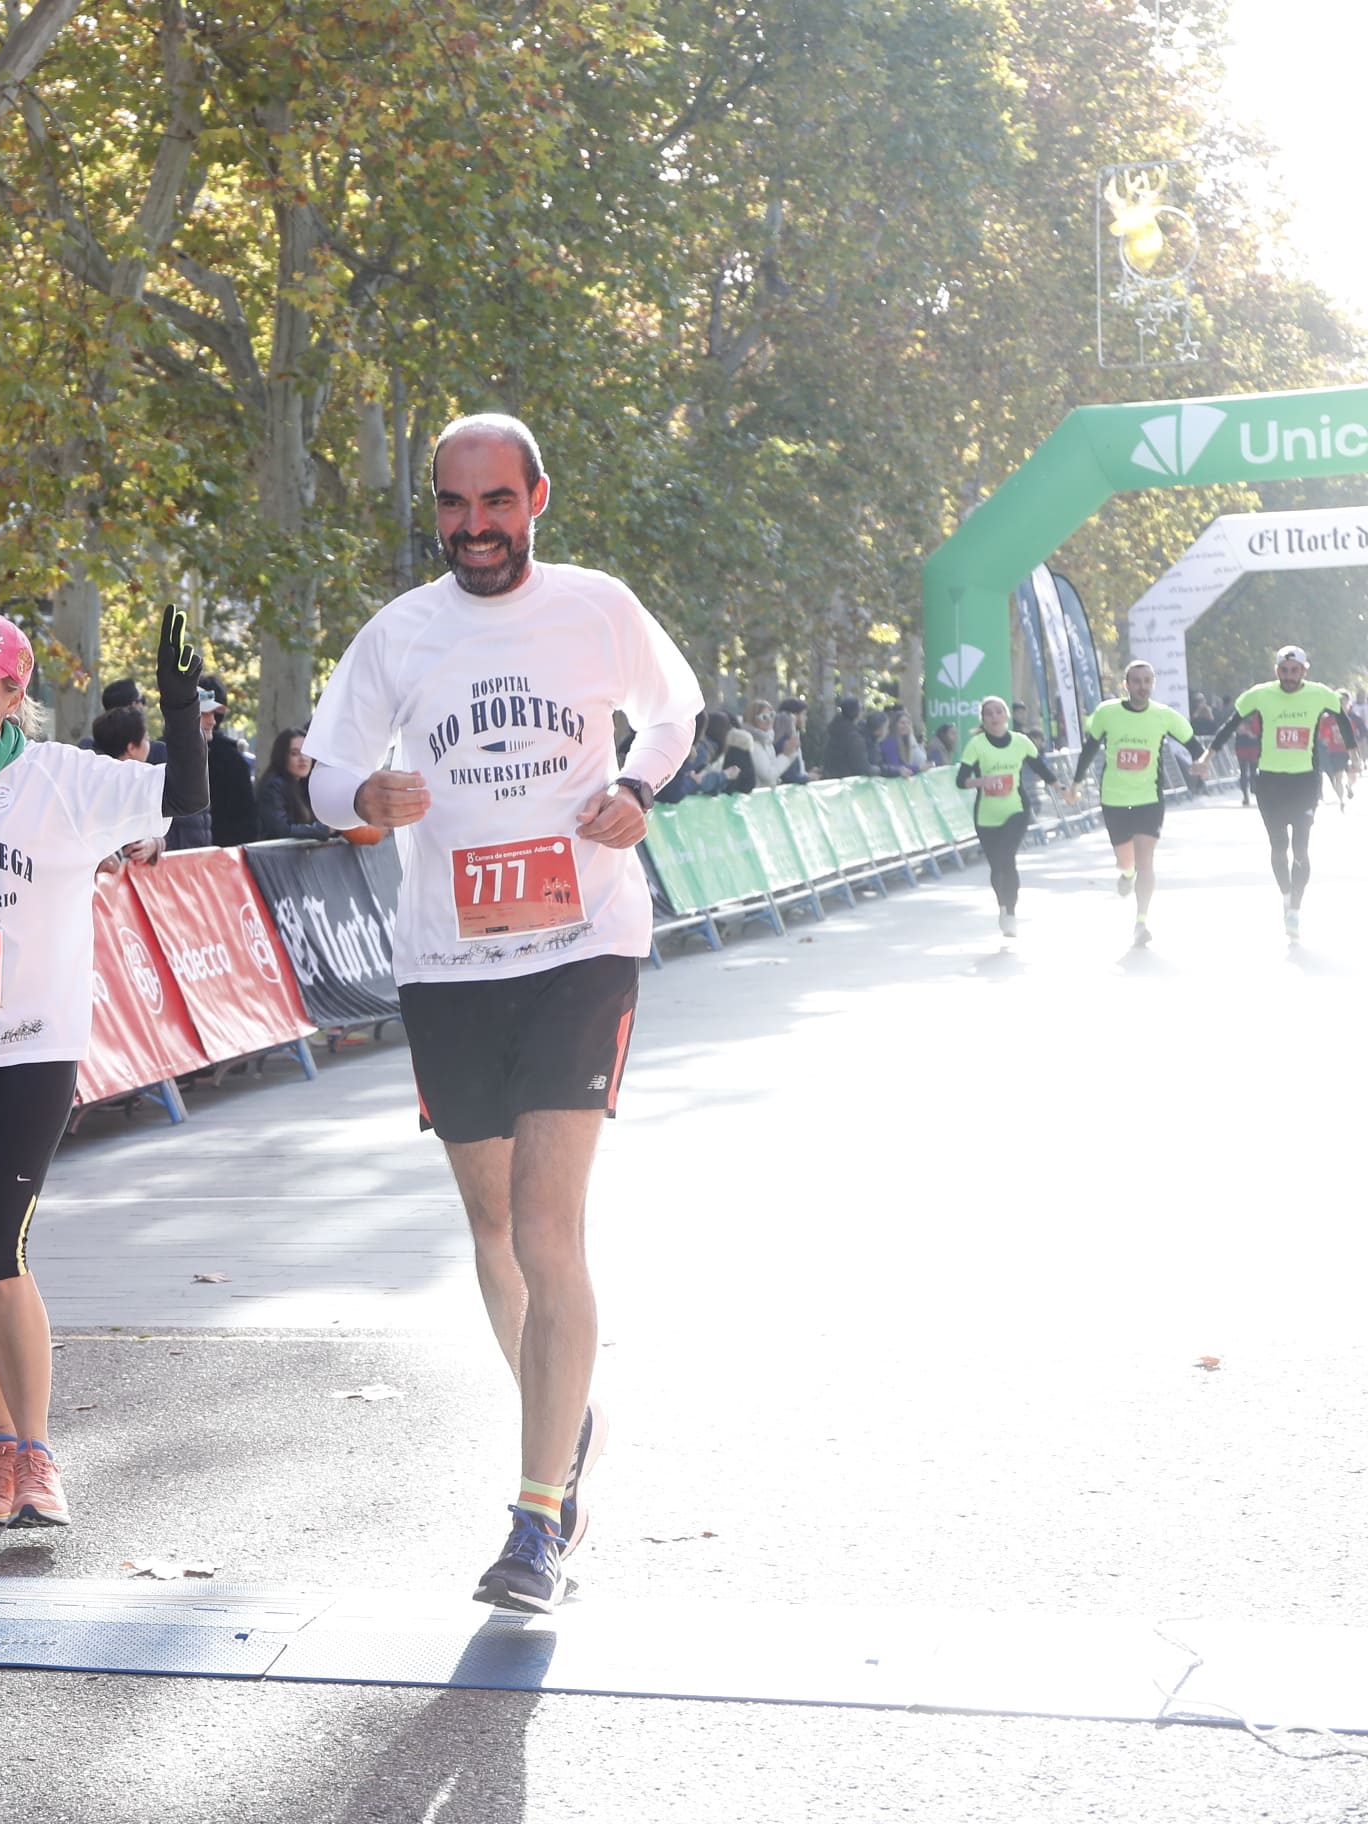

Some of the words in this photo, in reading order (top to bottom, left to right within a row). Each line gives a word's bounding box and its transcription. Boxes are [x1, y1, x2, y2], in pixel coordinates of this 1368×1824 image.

[472, 676, 531, 699] HOSPITAL
[429, 713, 460, 766] RIO
[470, 695, 585, 745] HORTEGA
[1280, 729, 1299, 743] 576
[450, 755, 568, 785] UNIVERSITARIO
[493, 785, 527, 802] 1953
[503, 848, 533, 859] empresas
[466, 859, 526, 904] 777
